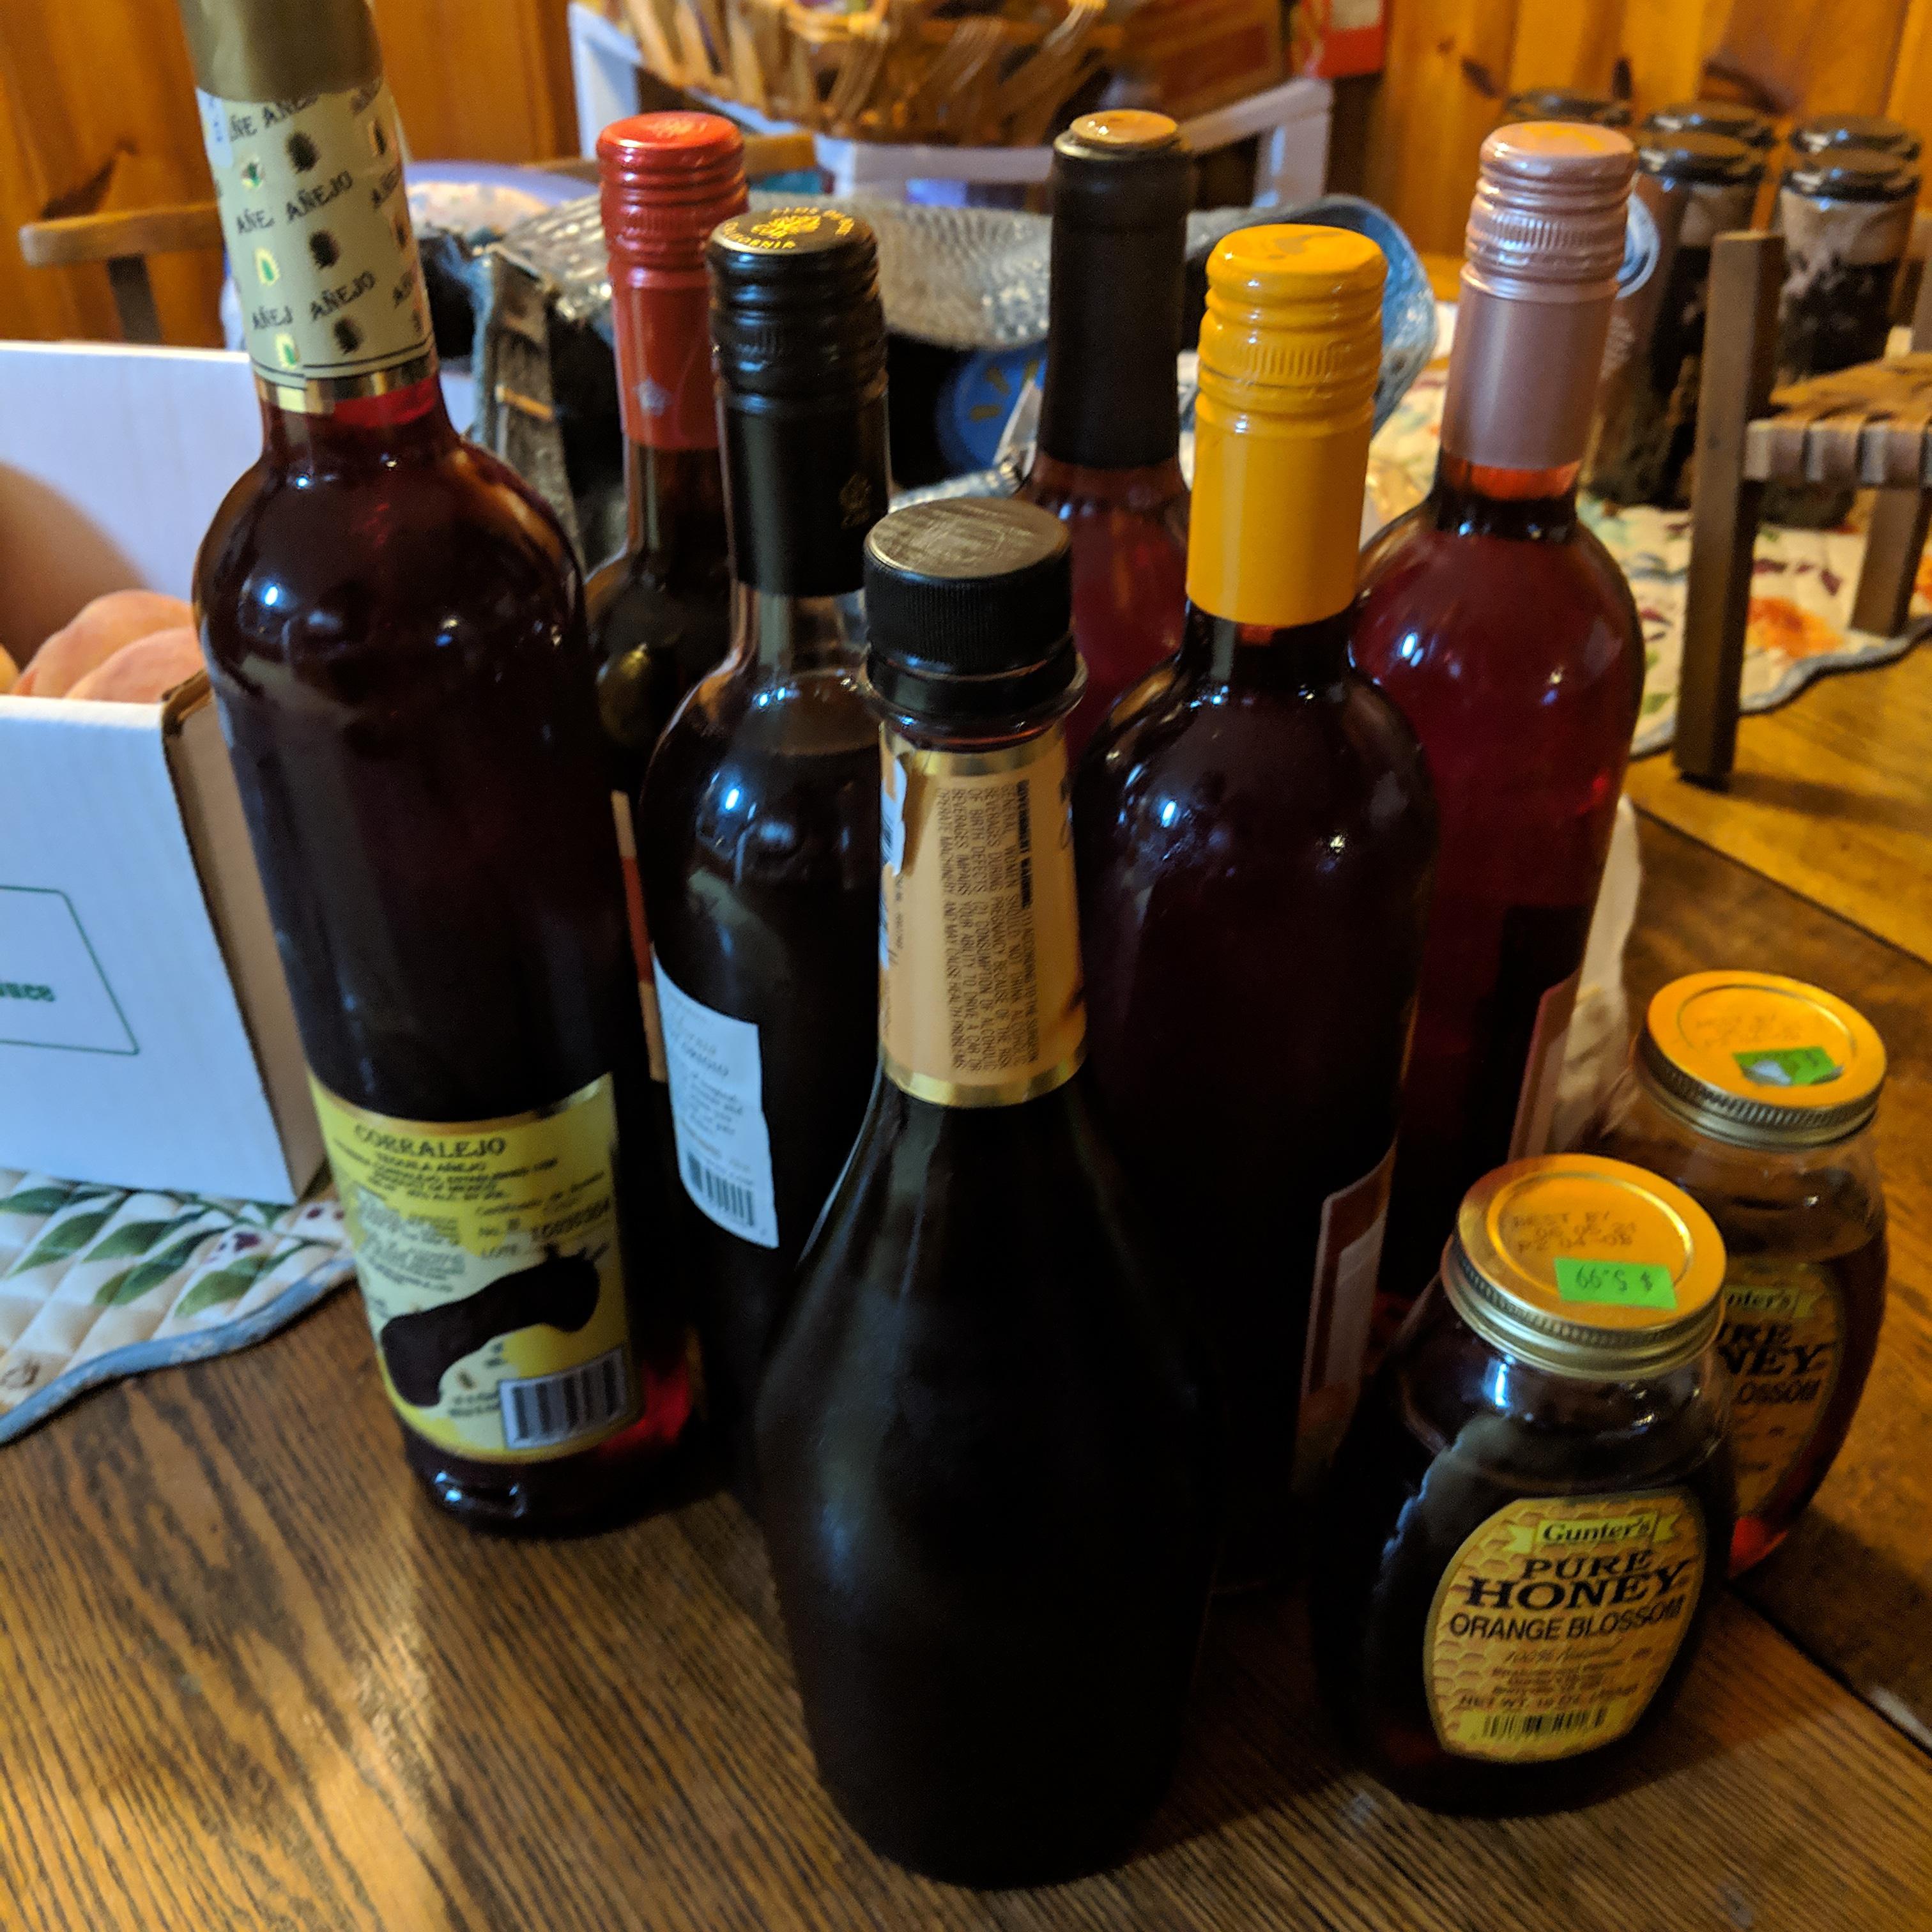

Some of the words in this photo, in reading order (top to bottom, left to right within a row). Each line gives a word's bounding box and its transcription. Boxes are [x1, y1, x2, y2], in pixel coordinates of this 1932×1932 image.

[286, 170, 353, 222] AÑEJO
[311, 270, 376, 322] AÑEJO
[969, 809, 985, 839] BIRTH
[958, 901, 973, 928] YOUR
[976, 921, 992, 994] CONSUMPTION
[963, 974, 977, 987] TO
[964, 992, 978, 1018] DRIVE
[967, 1036, 980, 1054] CAR
[981, 1018, 997, 1071] ALCOHOLIC
[355, 1124, 507, 1158] CORRALEJO
[1717, 1342, 1837, 1376] NEY
[1542, 1515, 1651, 1543] Gunter's
[1521, 1548, 1654, 1579] PURE
[1464, 1558, 1692, 1611] HONEY
[1450, 1612, 1565, 1641] ORANGE
[1566, 1595, 1685, 1640] BLOSSOM
